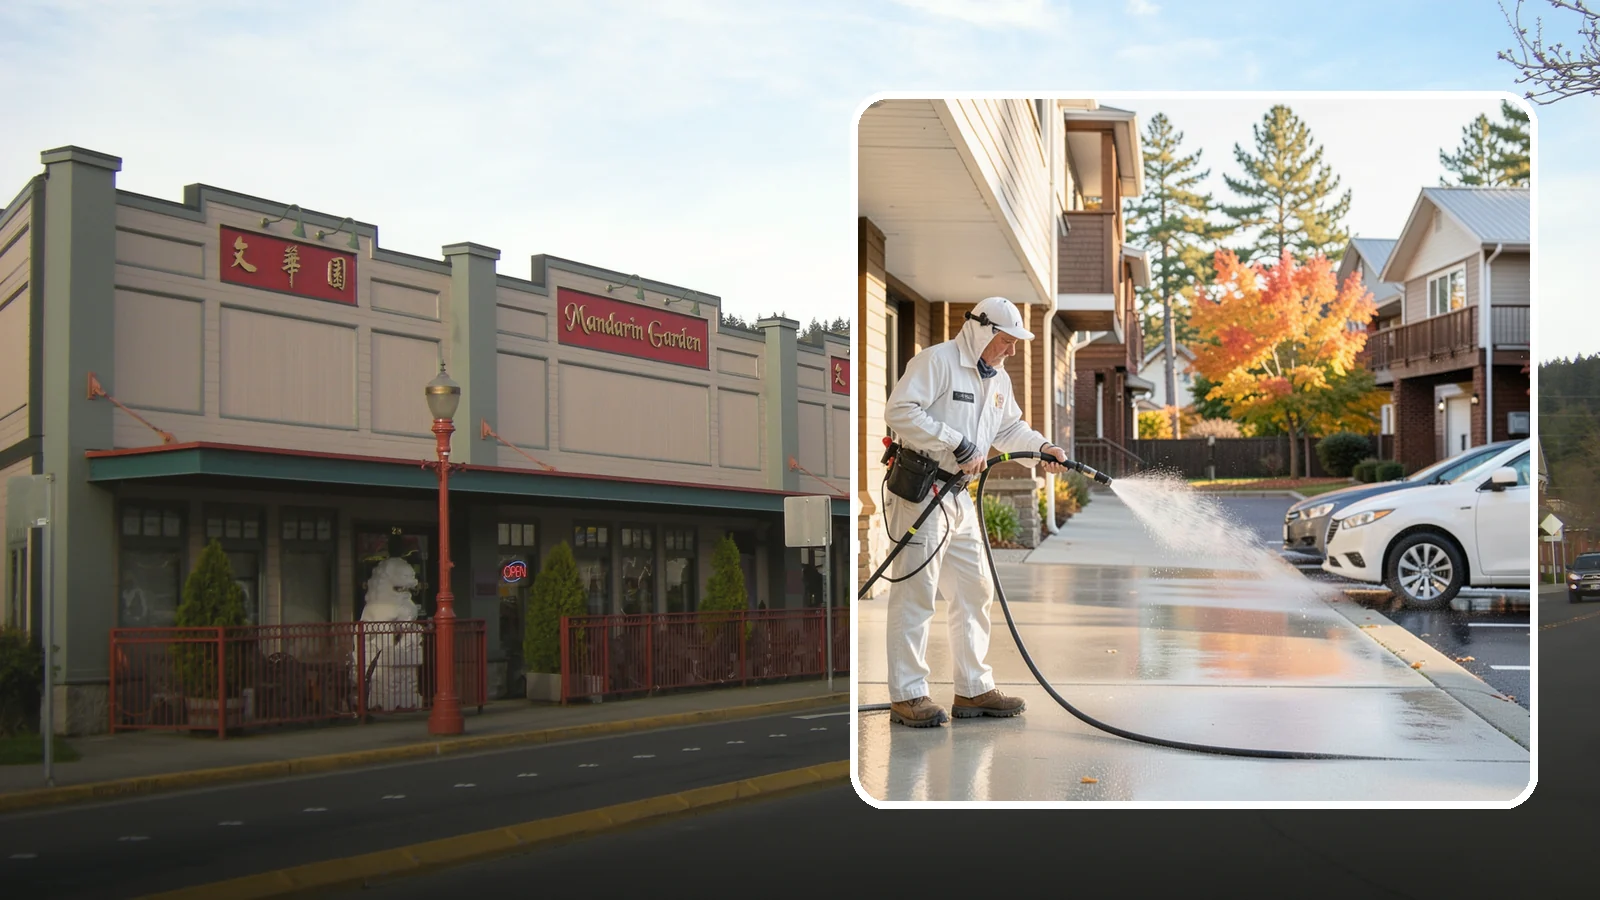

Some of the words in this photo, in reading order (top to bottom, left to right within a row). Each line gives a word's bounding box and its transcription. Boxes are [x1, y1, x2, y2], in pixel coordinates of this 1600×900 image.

[231, 235, 346, 290] 文華園
[564, 302, 644, 341] Mandarin
[648, 320, 701, 352] Garden
[503, 565, 527, 578] OPEN
